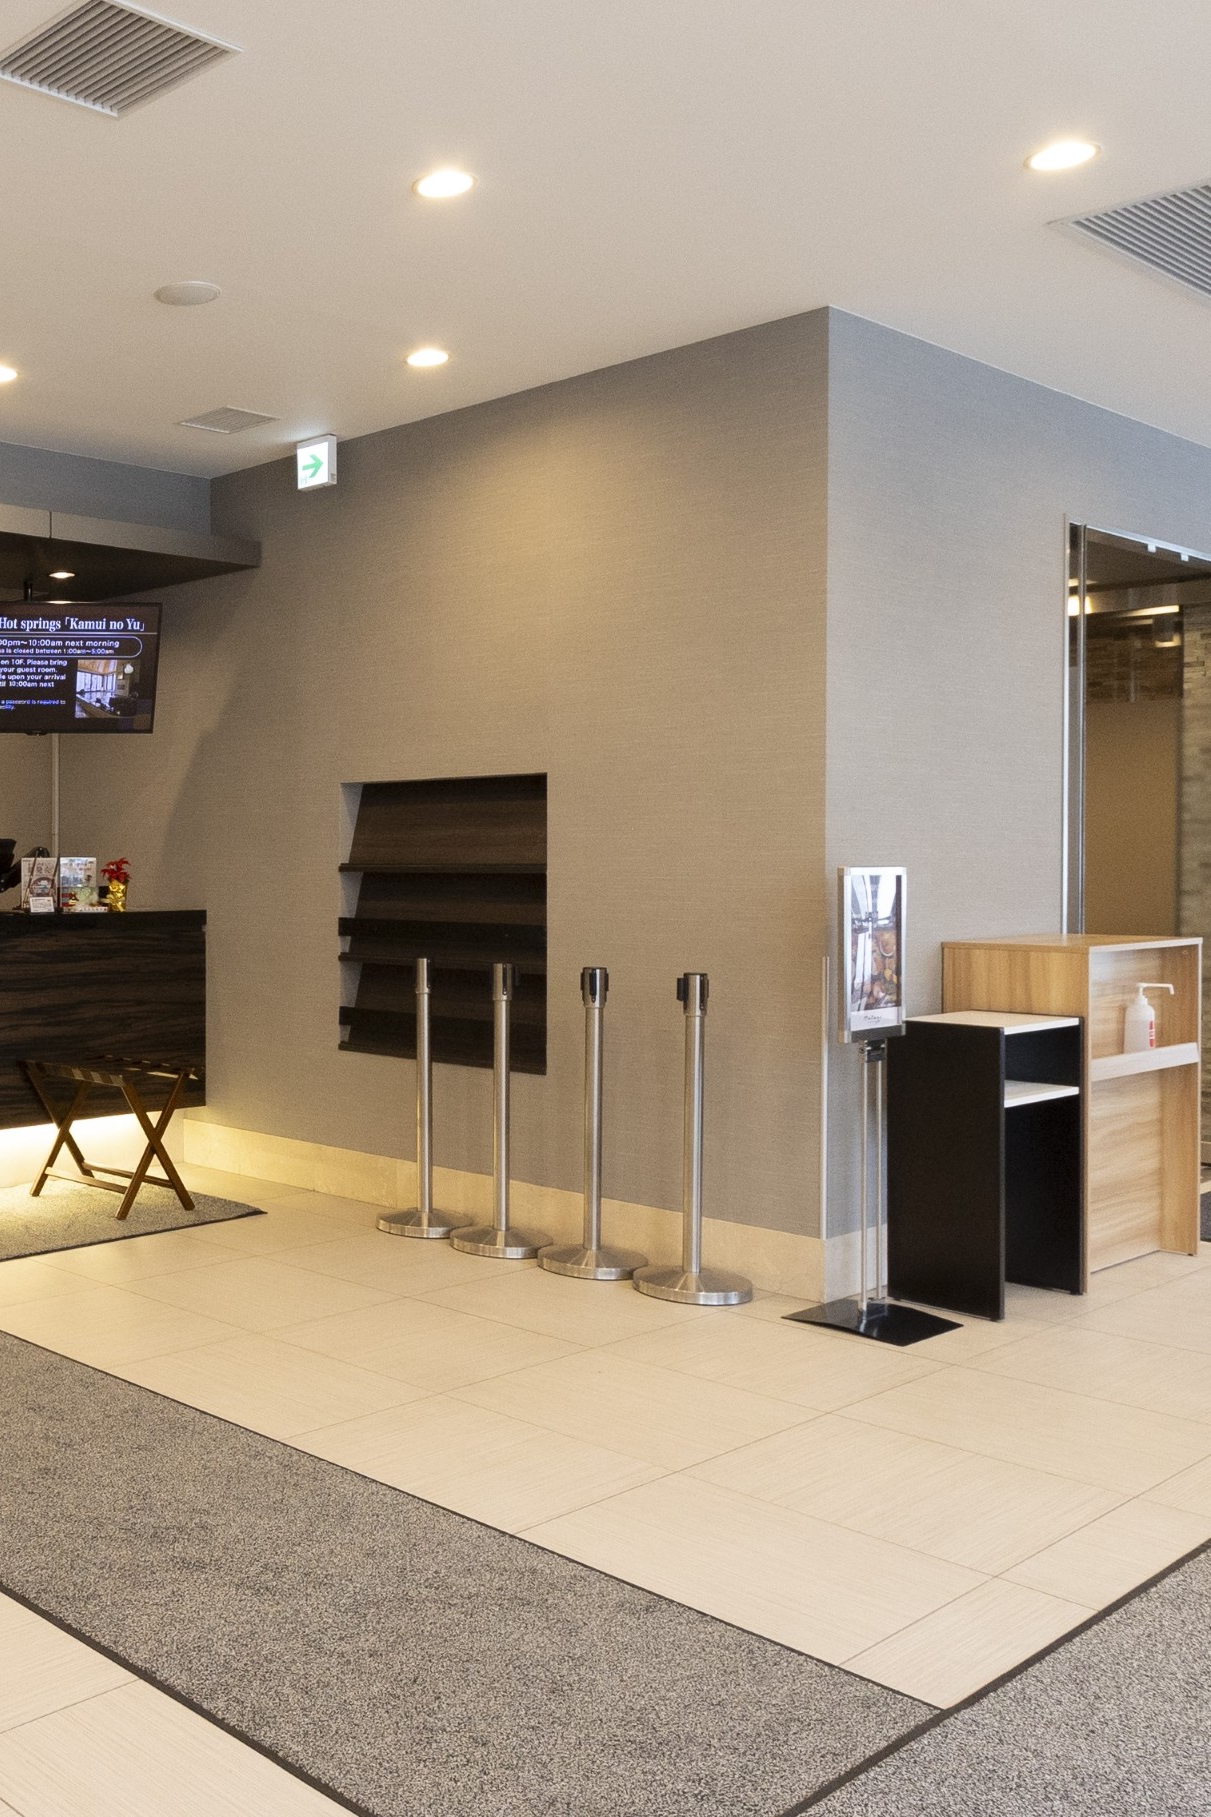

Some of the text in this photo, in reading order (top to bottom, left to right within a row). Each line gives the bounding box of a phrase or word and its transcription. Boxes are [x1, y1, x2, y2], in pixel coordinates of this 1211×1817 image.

[21, 617, 61, 632] springs
[110, 621, 124, 630] no
[86, 639, 120, 648] morning
